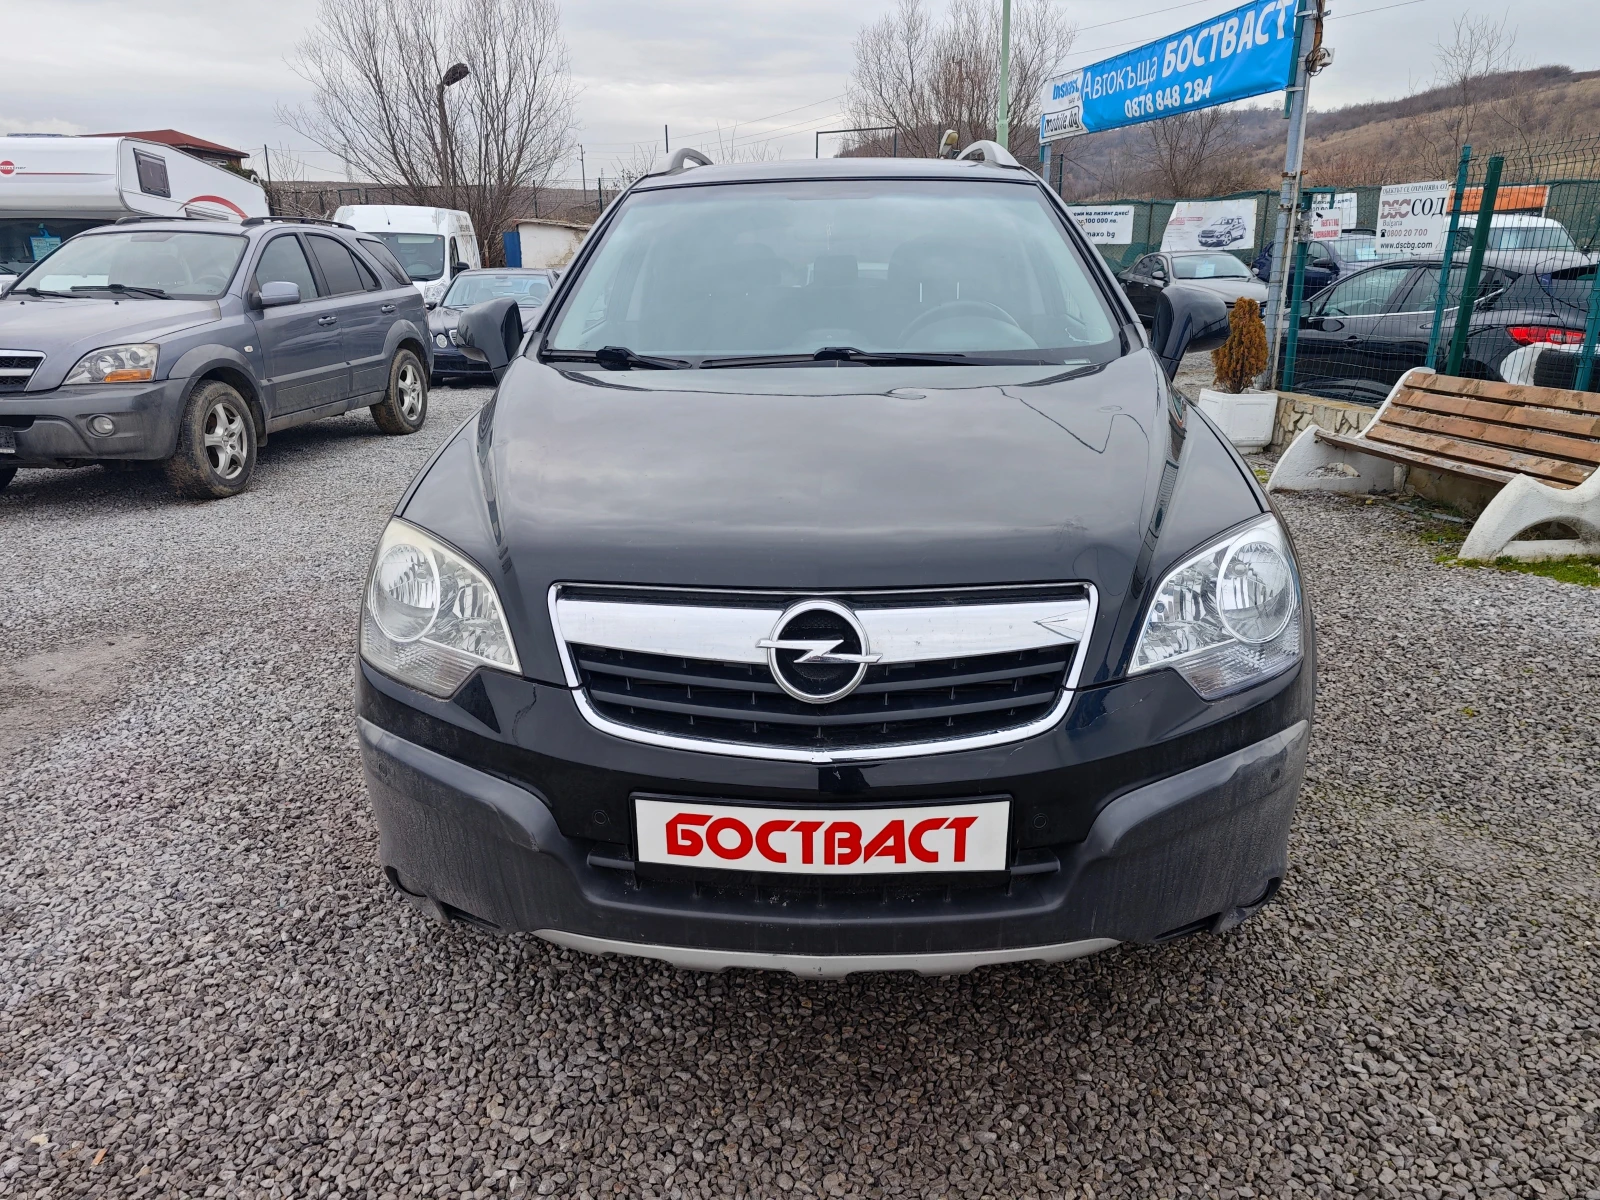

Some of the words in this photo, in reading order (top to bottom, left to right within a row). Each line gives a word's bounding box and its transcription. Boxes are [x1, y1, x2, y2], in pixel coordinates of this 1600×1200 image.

[1162, 0, 1293, 78] БОСТВАСТ
[1124, 92, 1154, 118] 0878
[1155, 85, 1181, 111] 848
[1184, 75, 1213, 104] 284
[1411, 197, 1447, 219] СОД
[1380, 241, 1433, 250] www.dscbg.com
[1387, 229, 1403, 237] 0800
[1403, 229, 1412, 237] 20
[1413, 228, 1428, 237] 700
[666, 813, 979, 865] БОСТВАСТ
